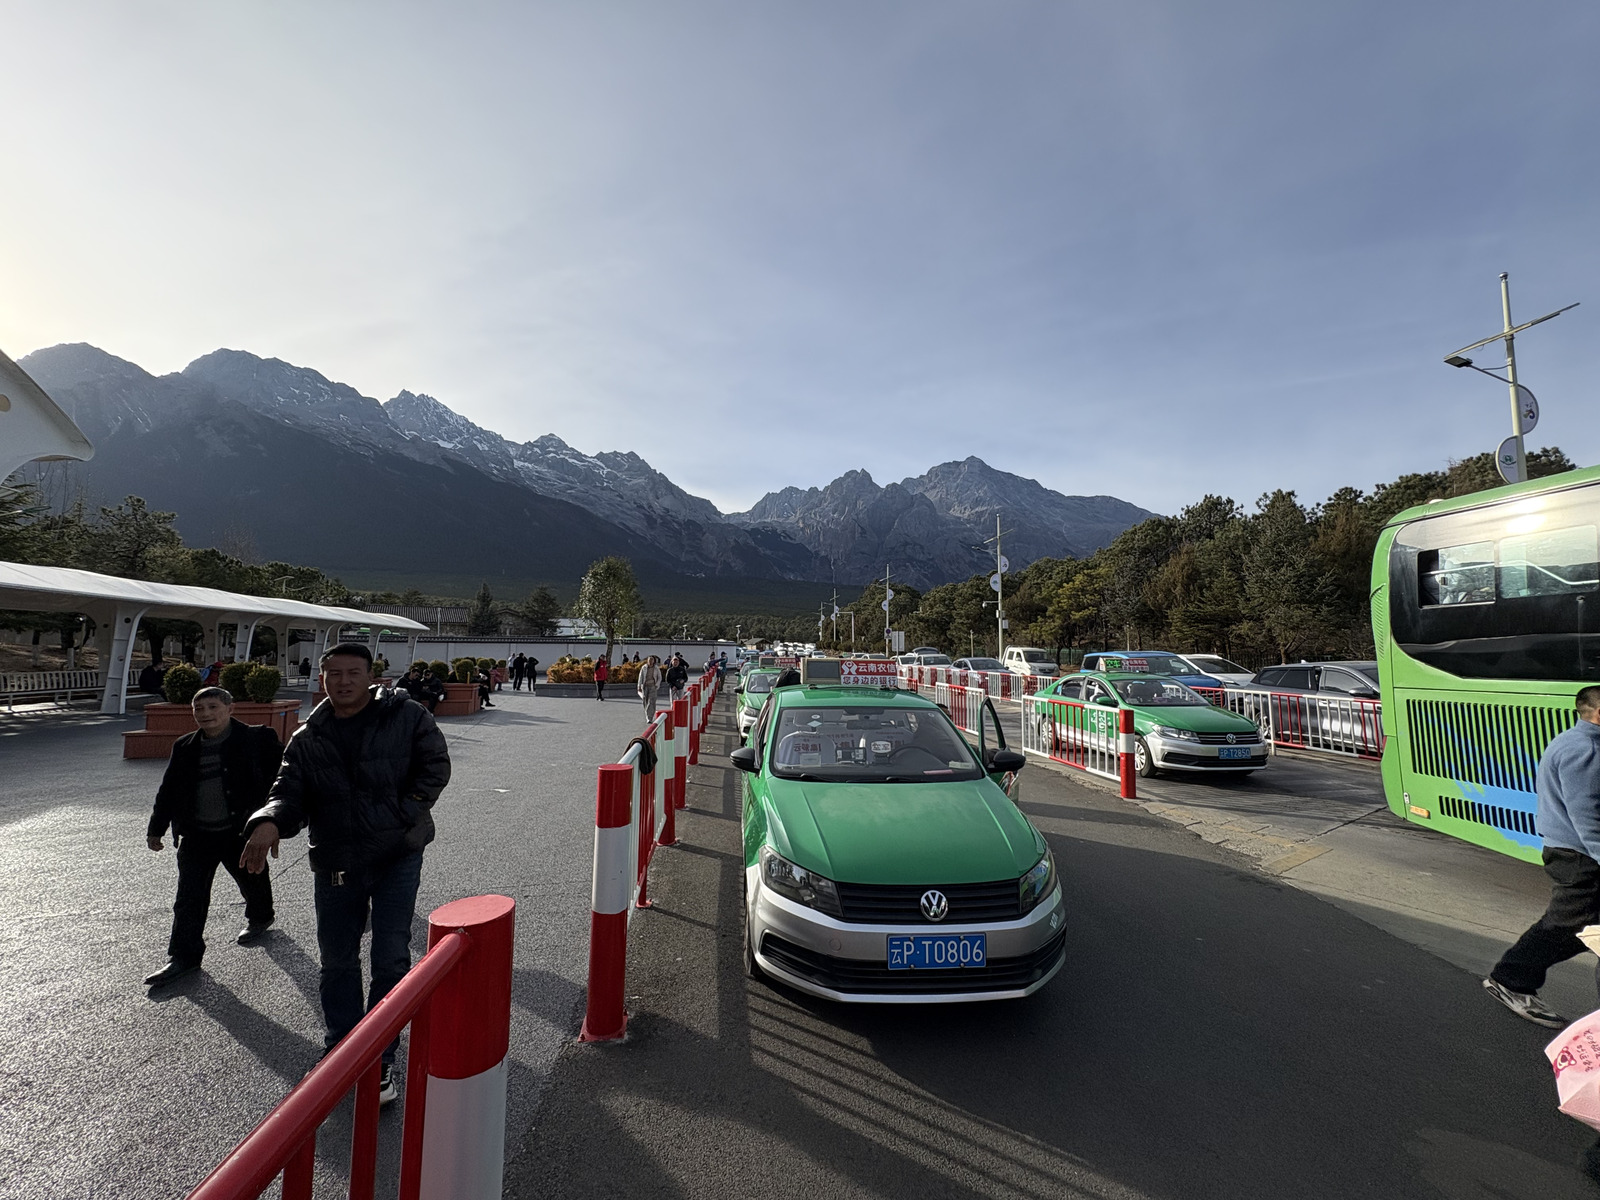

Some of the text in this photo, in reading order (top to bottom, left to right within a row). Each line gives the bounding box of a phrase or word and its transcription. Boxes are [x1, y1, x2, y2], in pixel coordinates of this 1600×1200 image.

[858, 663, 896, 673] 云南农信
[843, 676, 896, 685] 您身边的银行
[891, 940, 983, 965] 云P·T0806
